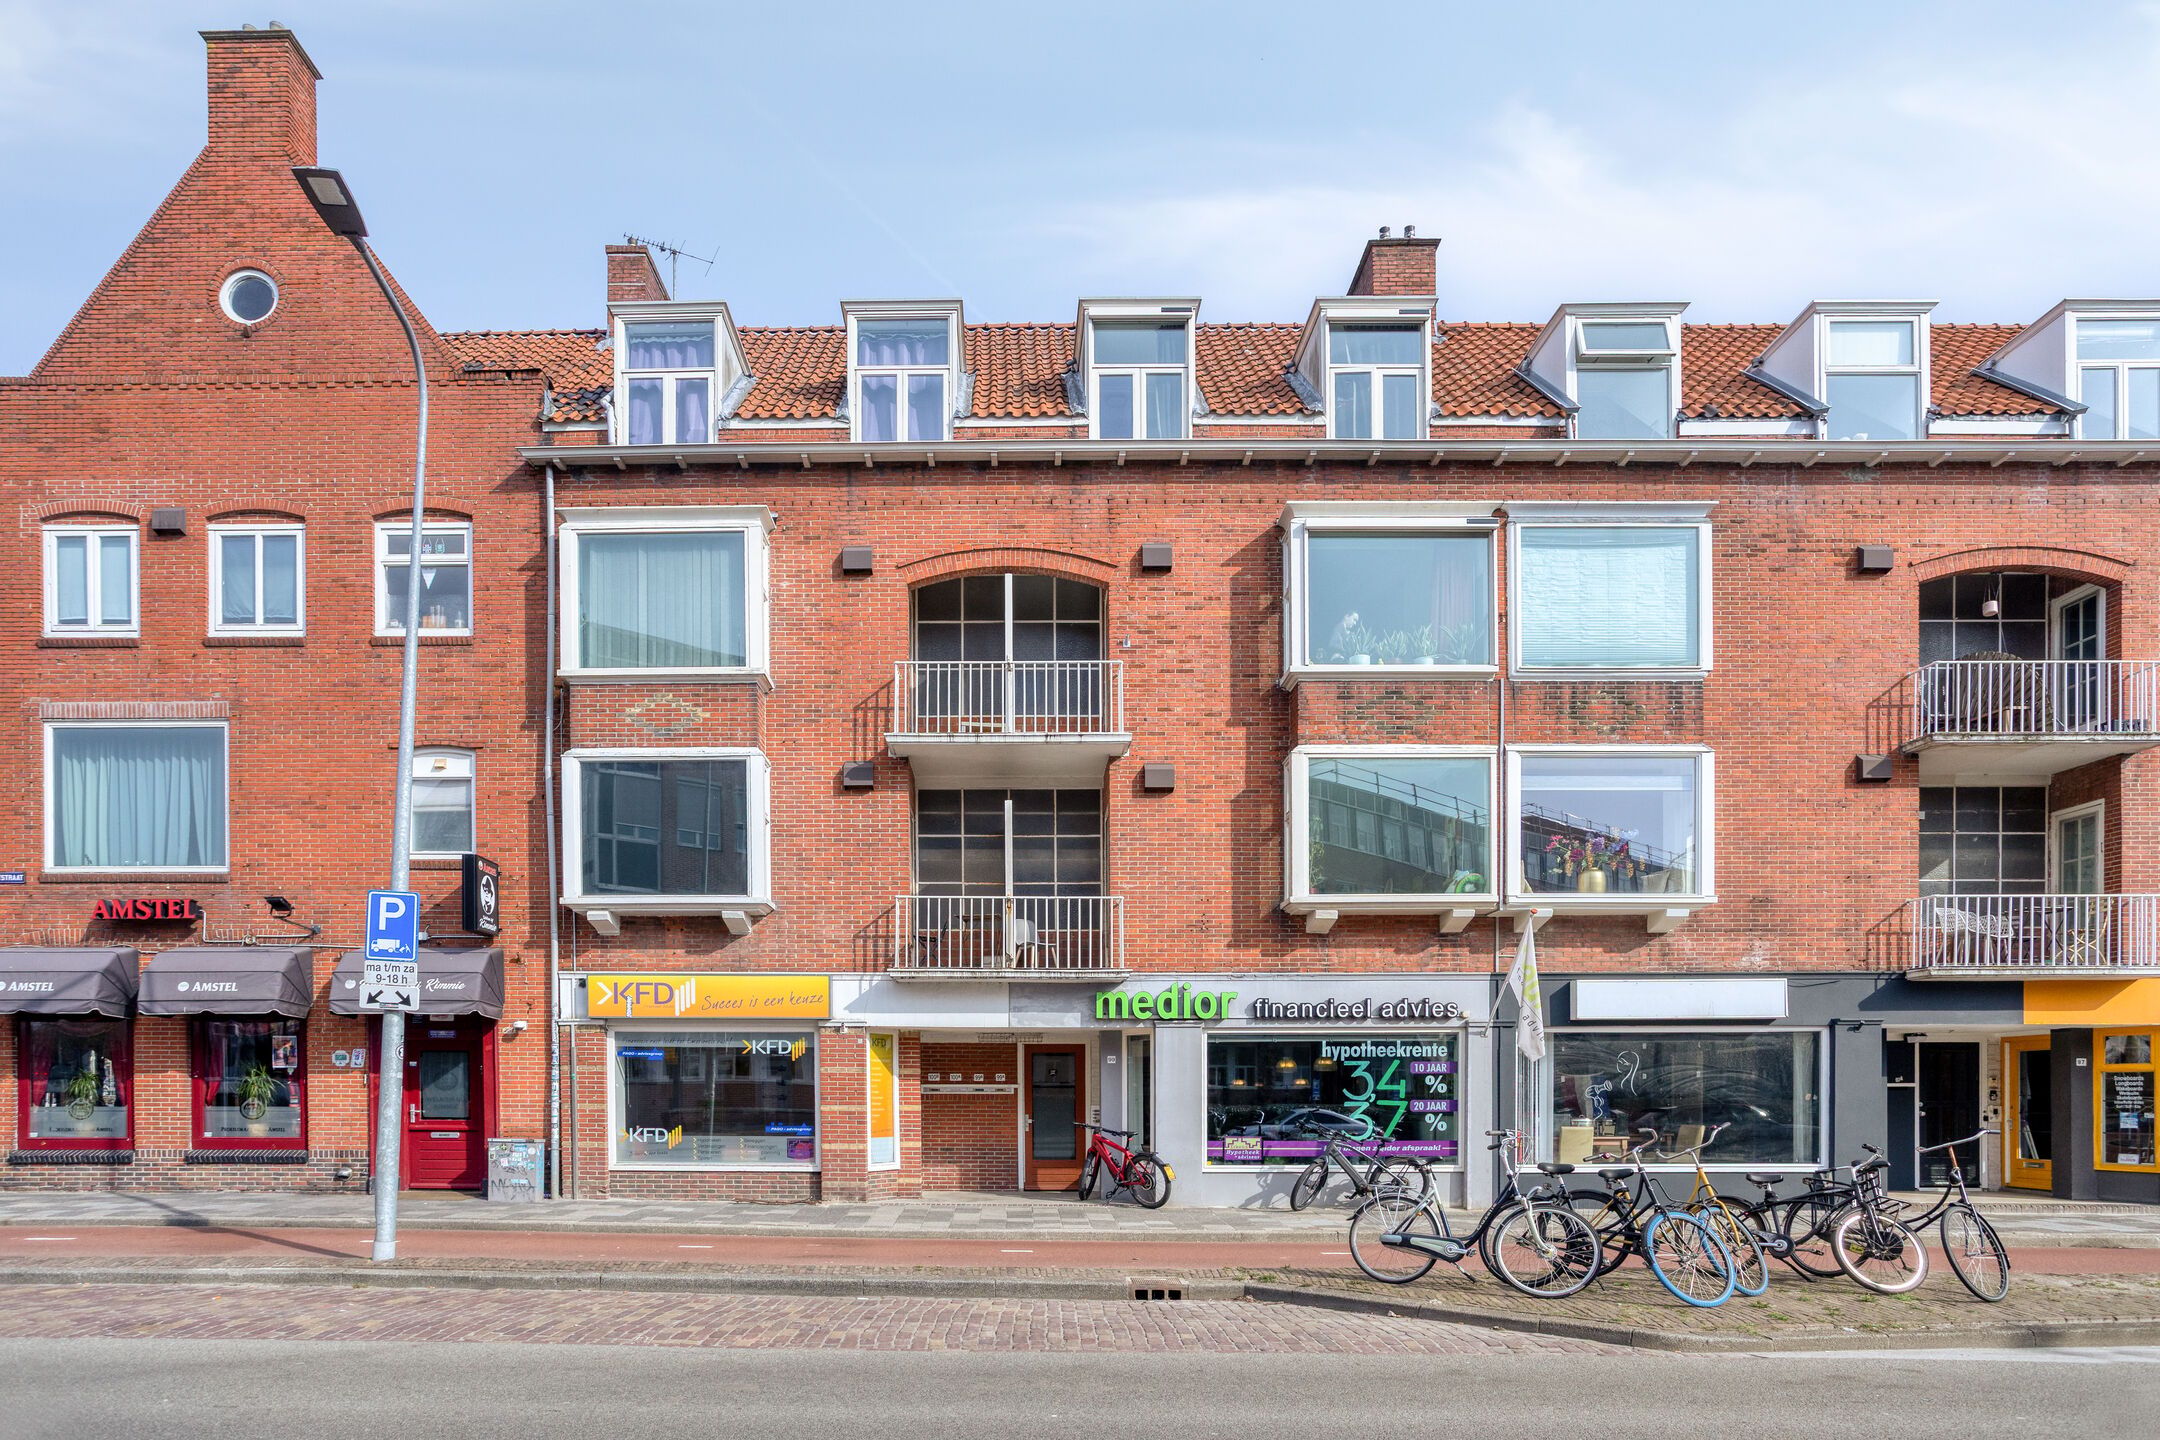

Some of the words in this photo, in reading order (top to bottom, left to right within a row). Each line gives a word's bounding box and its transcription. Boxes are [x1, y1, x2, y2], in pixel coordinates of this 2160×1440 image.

[92, 899, 196, 919] AMSTEL
[378, 896, 406, 931] P
[366, 963, 381, 972] ma
[384, 963, 401, 973] t/m
[403, 965, 415, 973] za
[7, 981, 55, 991] AMSTEL
[192, 981, 239, 992] AMSTEL
[375, 974, 399, 984] 9-18
[401, 975, 408, 984] h
[425, 978, 466, 992] Kimmie
[613, 982, 674, 1005] KFD
[701, 995, 743, 1011] Succes
[749, 995, 759, 1008] is
[763, 996, 784, 1007] een
[789, 991, 824, 1006] keuze
[1095, 982, 1238, 1020] medior
[1254, 998, 1372, 1018] financieel
[1381, 998, 1460, 1018] advies
[752, 1039, 792, 1055] KFD
[1321, 1040, 1448, 1061] hypotheekrente
[1414, 1064, 1424, 1072] 10
[1425, 1064, 1447, 1072] JAAR
[1425, 1075, 1448, 1094] %
[1414, 1102, 1424, 1110] 20
[1425, 1102, 1447, 1111] JAAR
[1425, 1113, 1448, 1132] %
[629, 1127, 668, 1143] KFD
[1402, 1144, 1441, 1153] afspraak!
